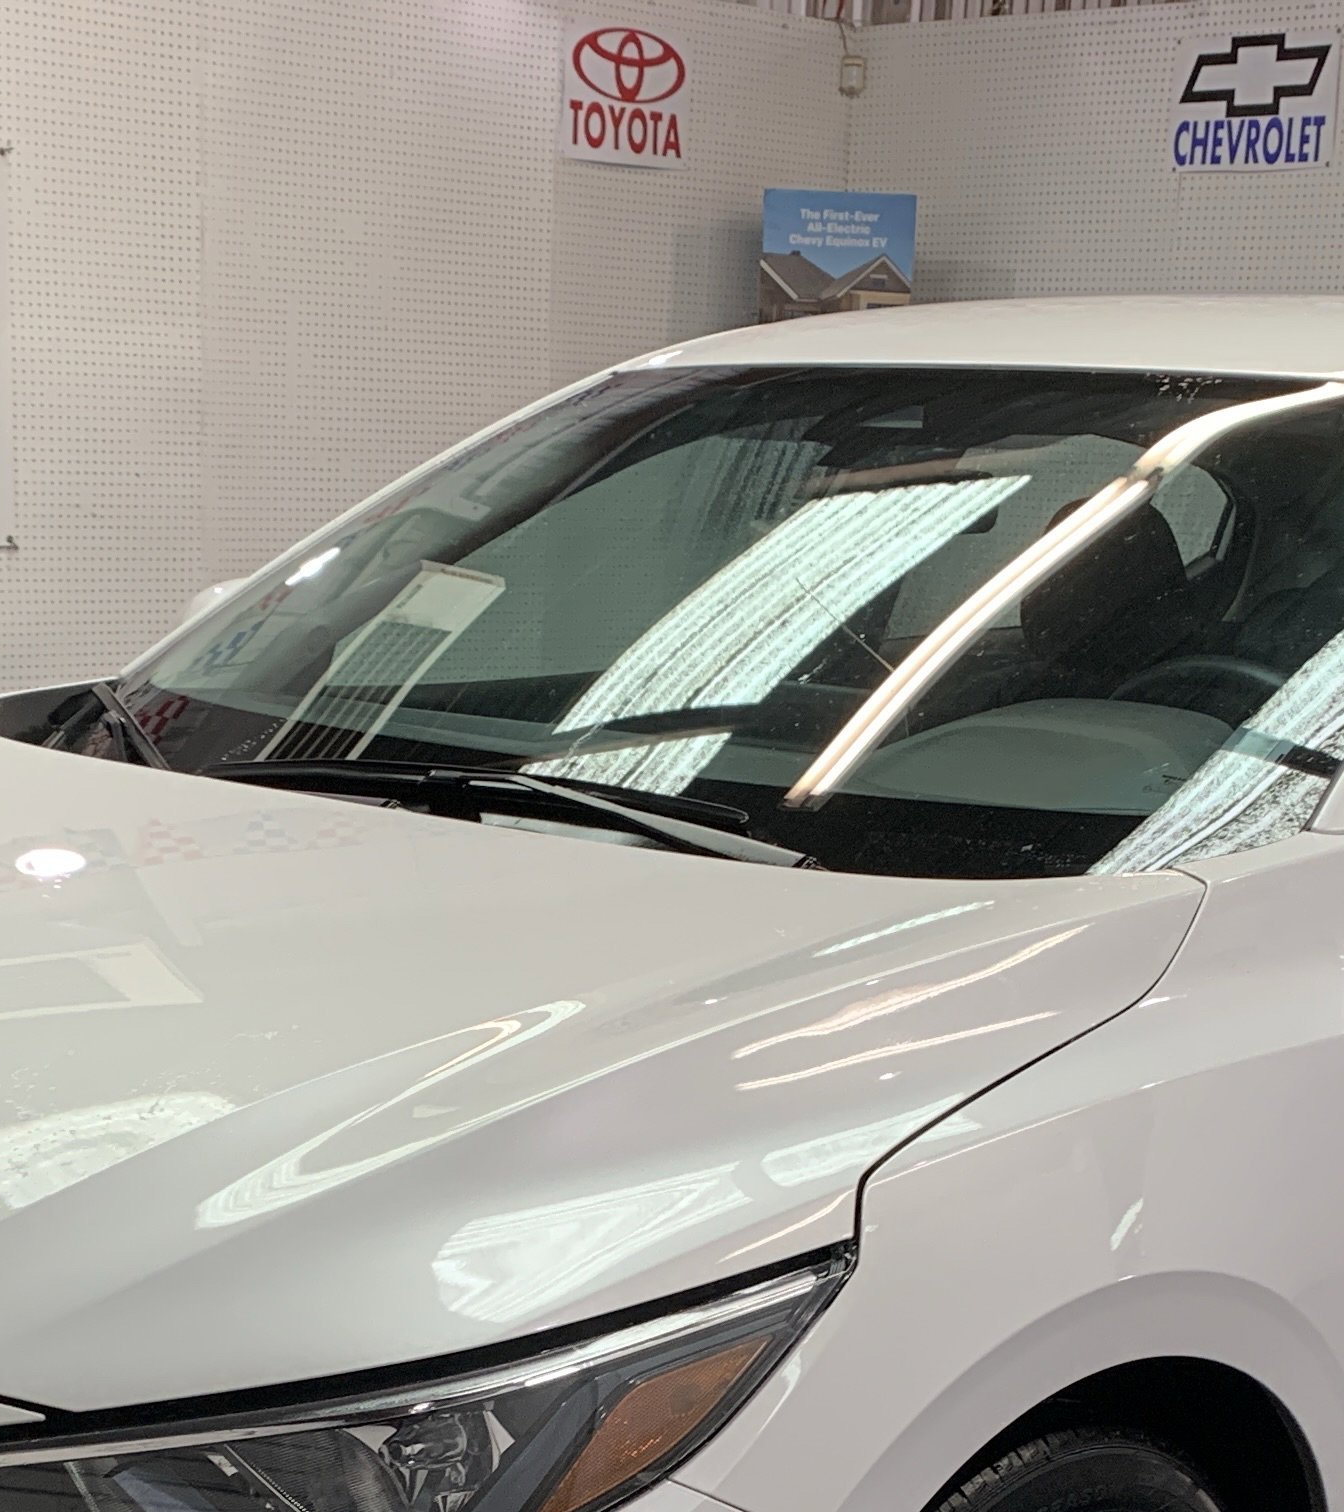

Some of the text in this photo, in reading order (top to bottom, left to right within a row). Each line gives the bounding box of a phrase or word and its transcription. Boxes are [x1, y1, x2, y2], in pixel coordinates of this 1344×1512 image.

[570, 99, 682, 159] TOYOTA
[1174, 115, 1326, 166] CHEVROLET
[800, 208, 821, 220] The
[872, 237, 888, 248] EV
